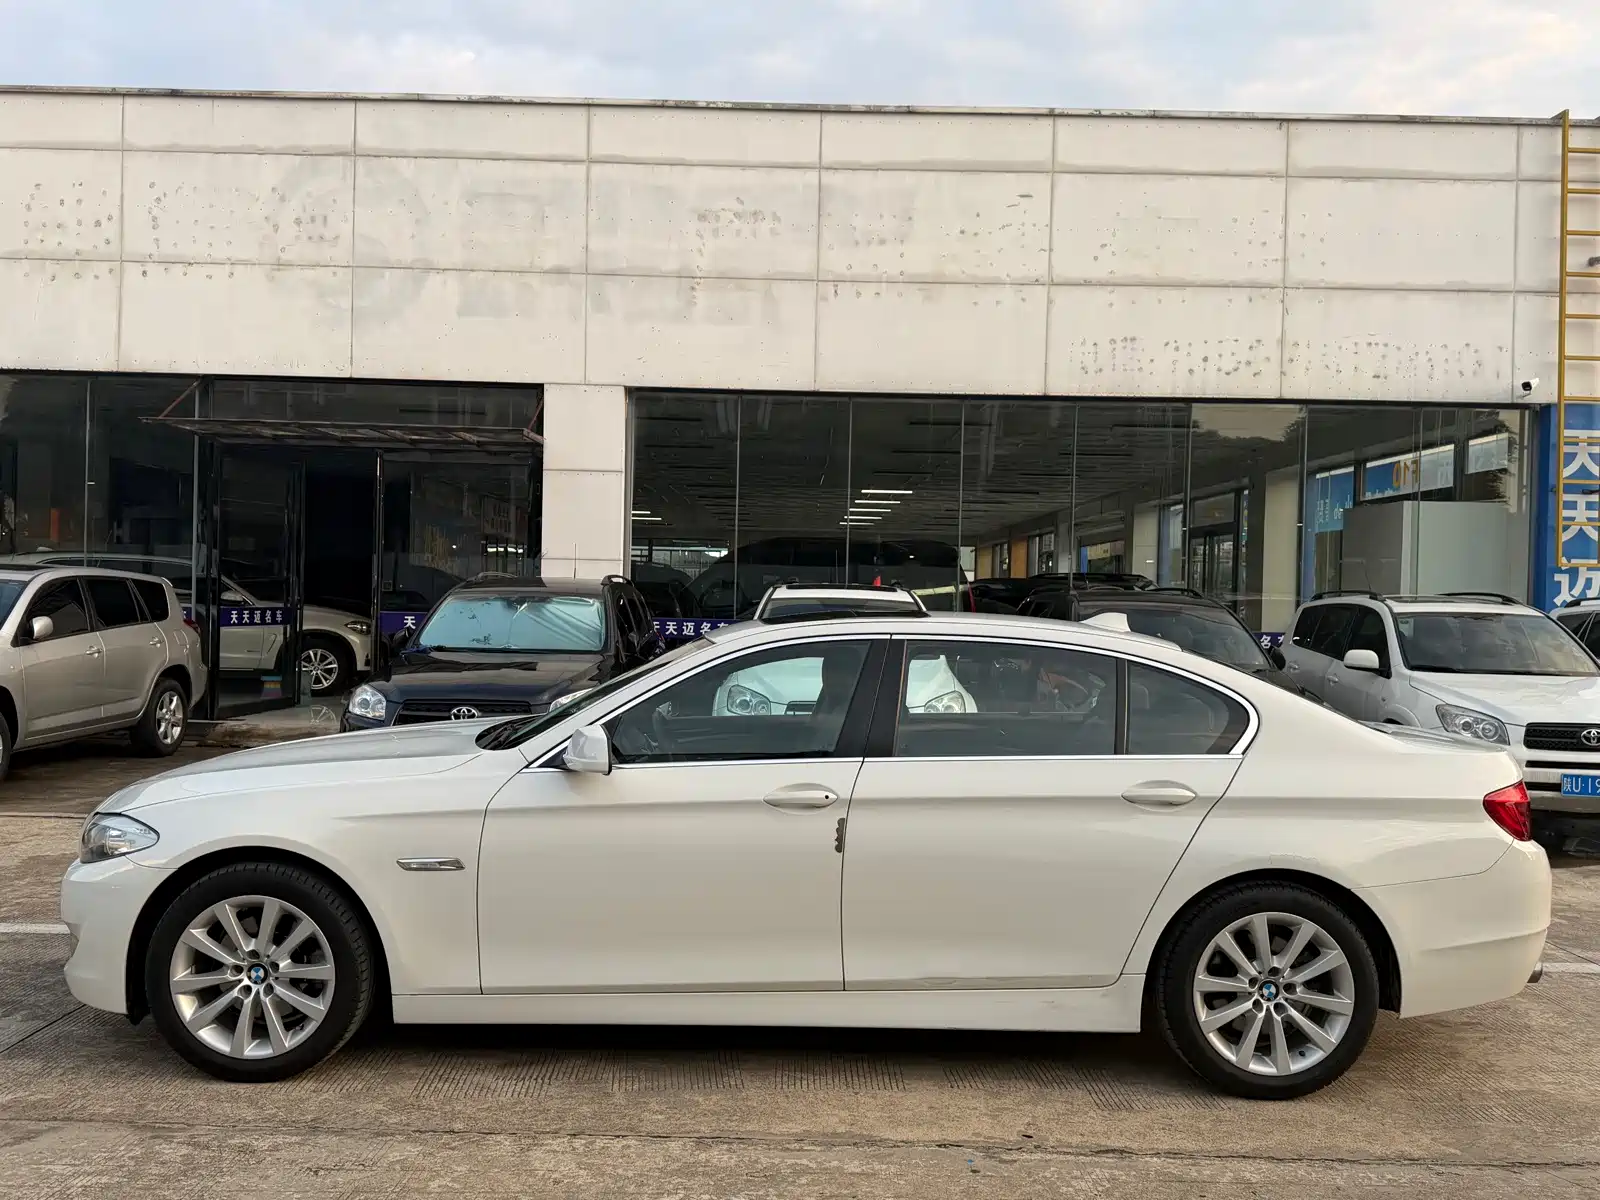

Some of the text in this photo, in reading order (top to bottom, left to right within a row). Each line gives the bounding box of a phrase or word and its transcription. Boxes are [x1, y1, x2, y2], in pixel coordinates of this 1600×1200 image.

[230, 610, 283, 624] 天天迈名车
[403, 615, 416, 629] 天
